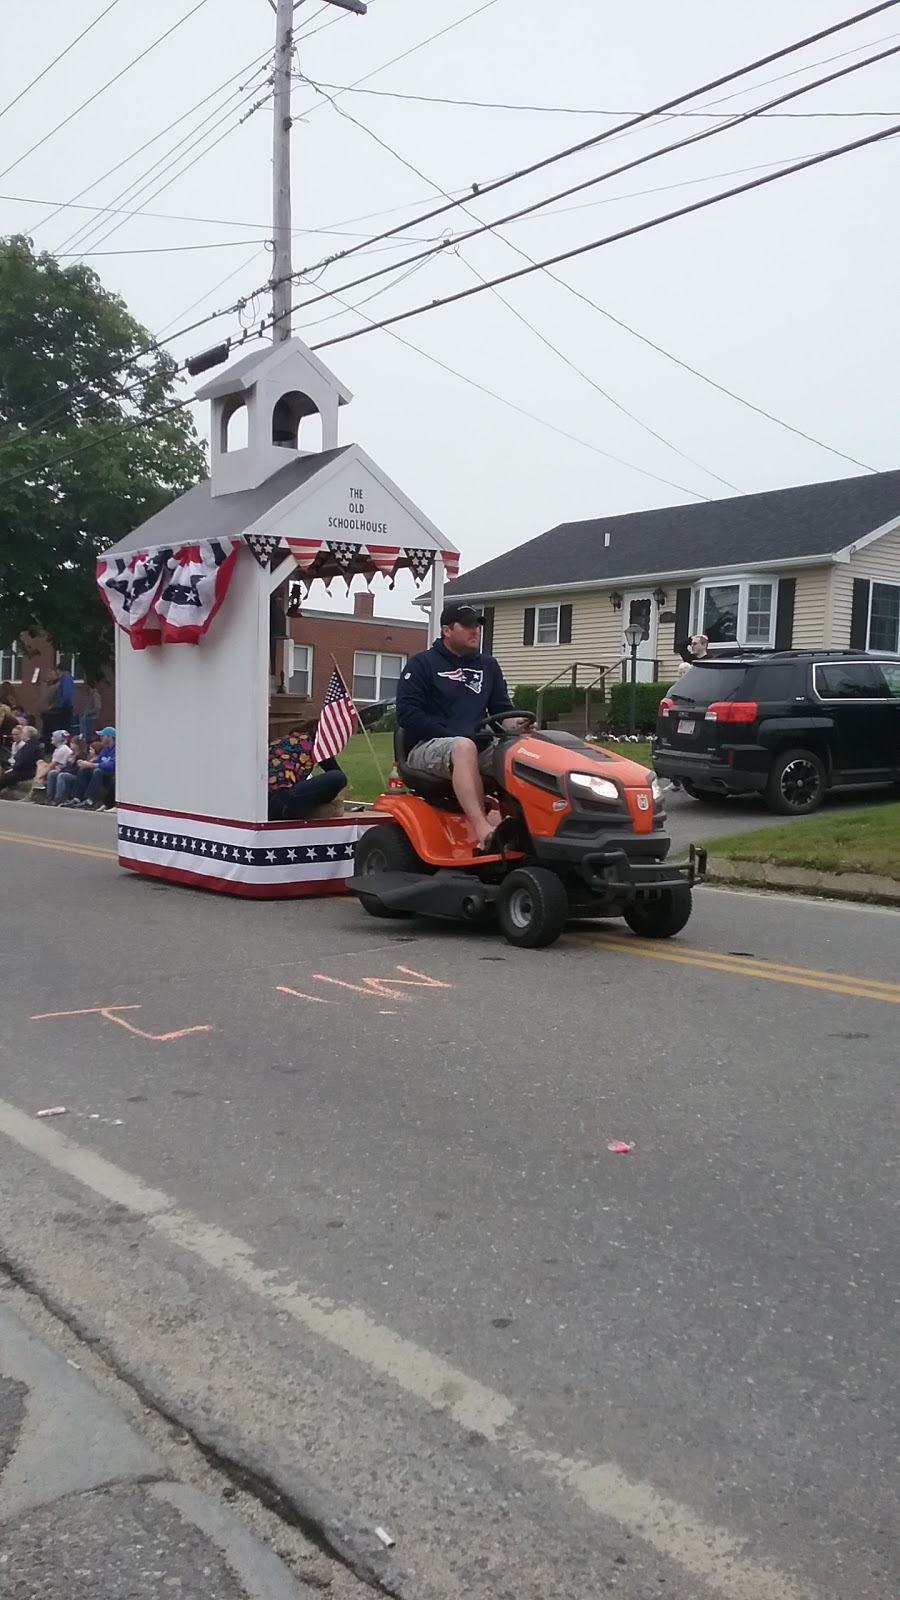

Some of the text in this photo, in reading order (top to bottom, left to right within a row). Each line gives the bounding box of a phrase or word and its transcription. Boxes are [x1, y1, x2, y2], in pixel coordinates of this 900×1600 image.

[350, 488, 363, 499] THE
[349, 503, 365, 514] OLD
[328, 516, 388, 534] SCHOOLHOUSE
